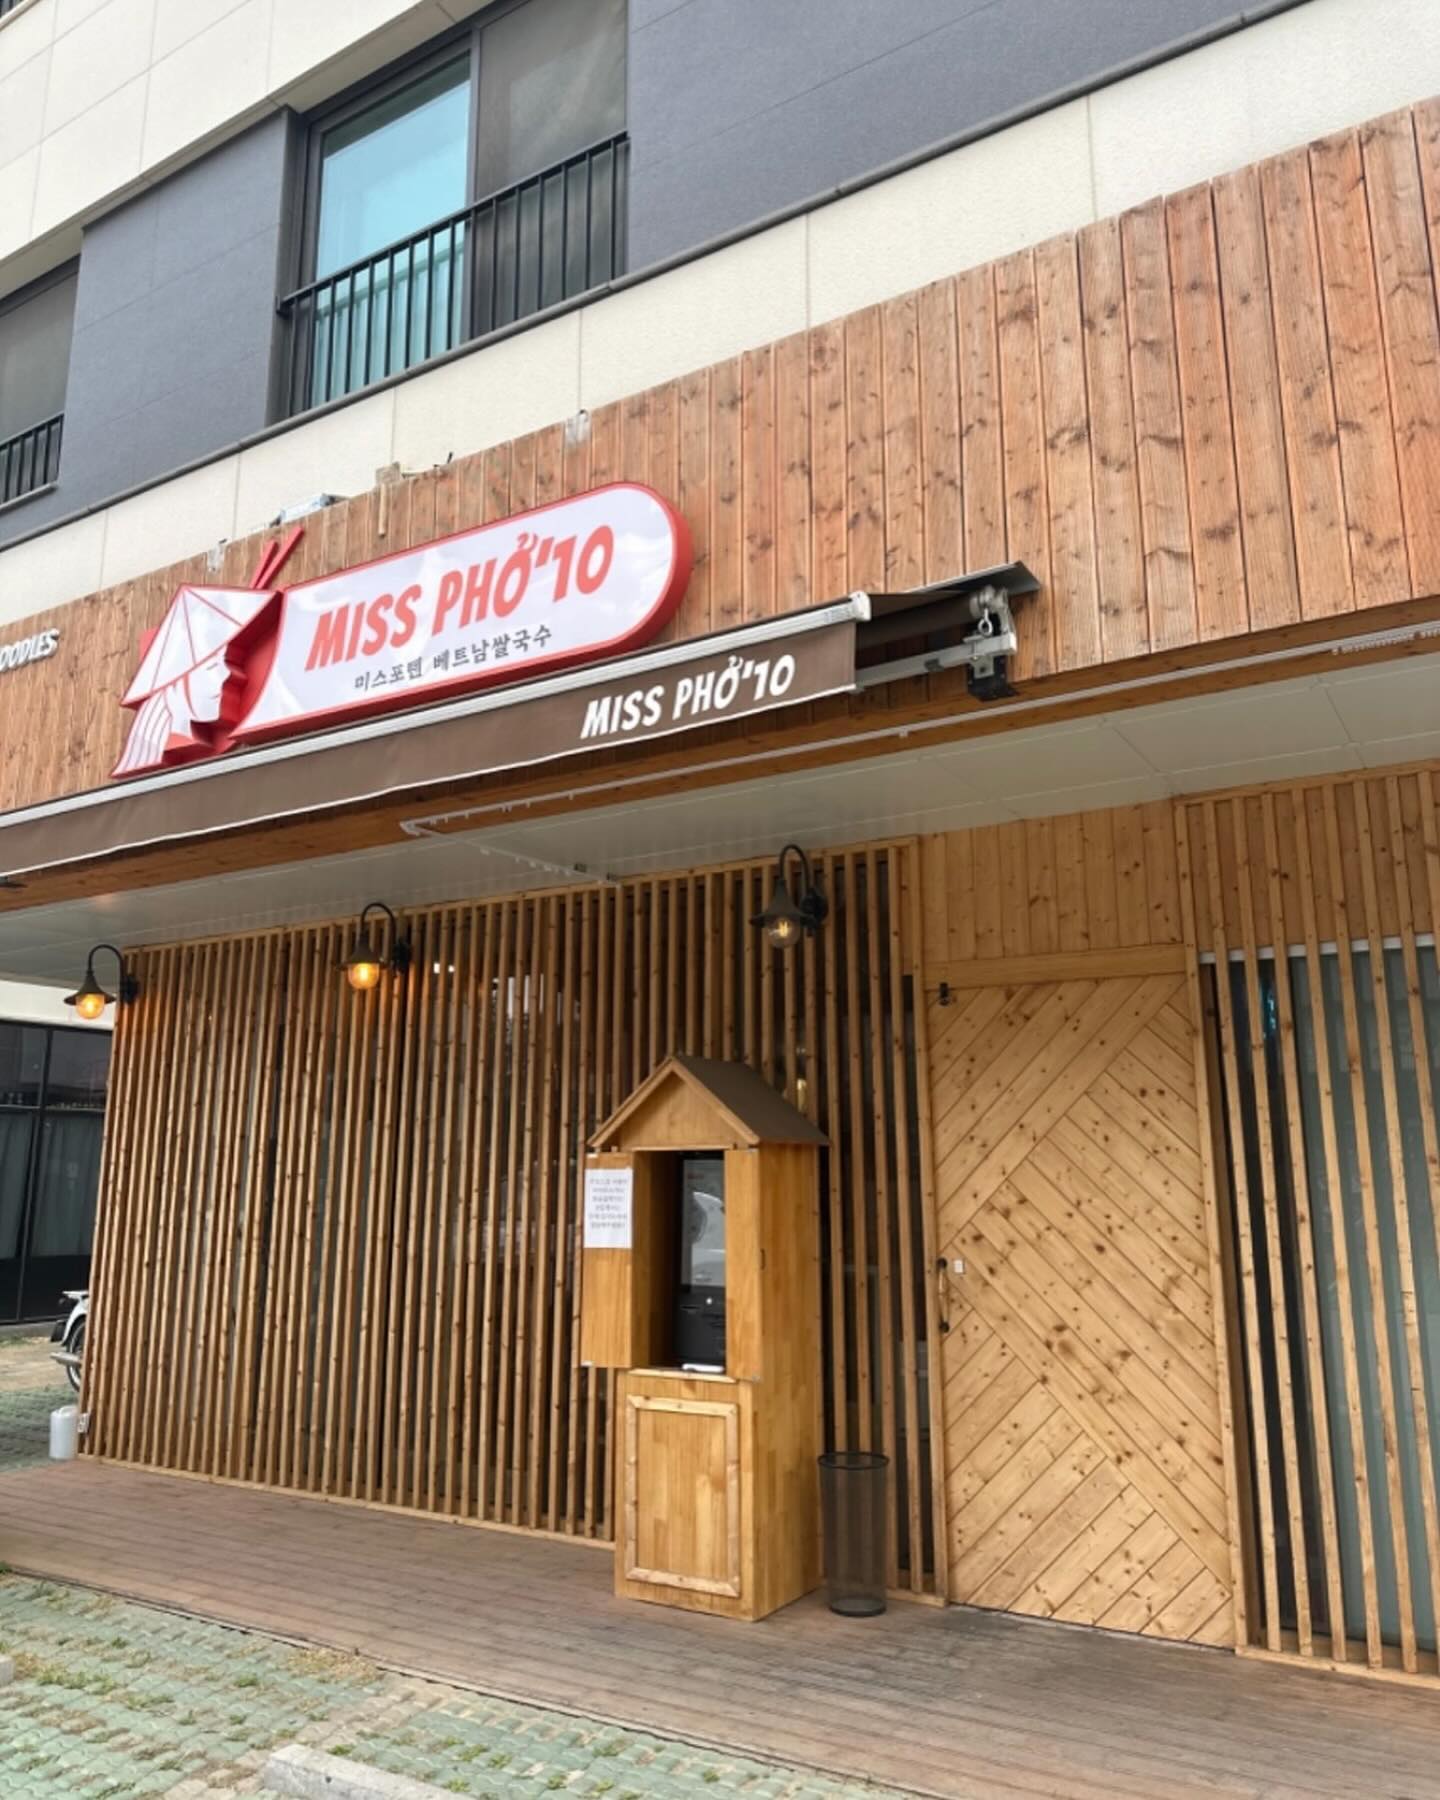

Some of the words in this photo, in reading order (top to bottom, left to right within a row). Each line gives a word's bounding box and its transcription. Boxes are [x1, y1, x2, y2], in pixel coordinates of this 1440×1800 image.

[305, 584, 422, 672] MISS
[354, 656, 423, 691] 미스포텐
[433, 624, 552, 672] 베트남쌀국수
[580, 685, 664, 739] MISS
